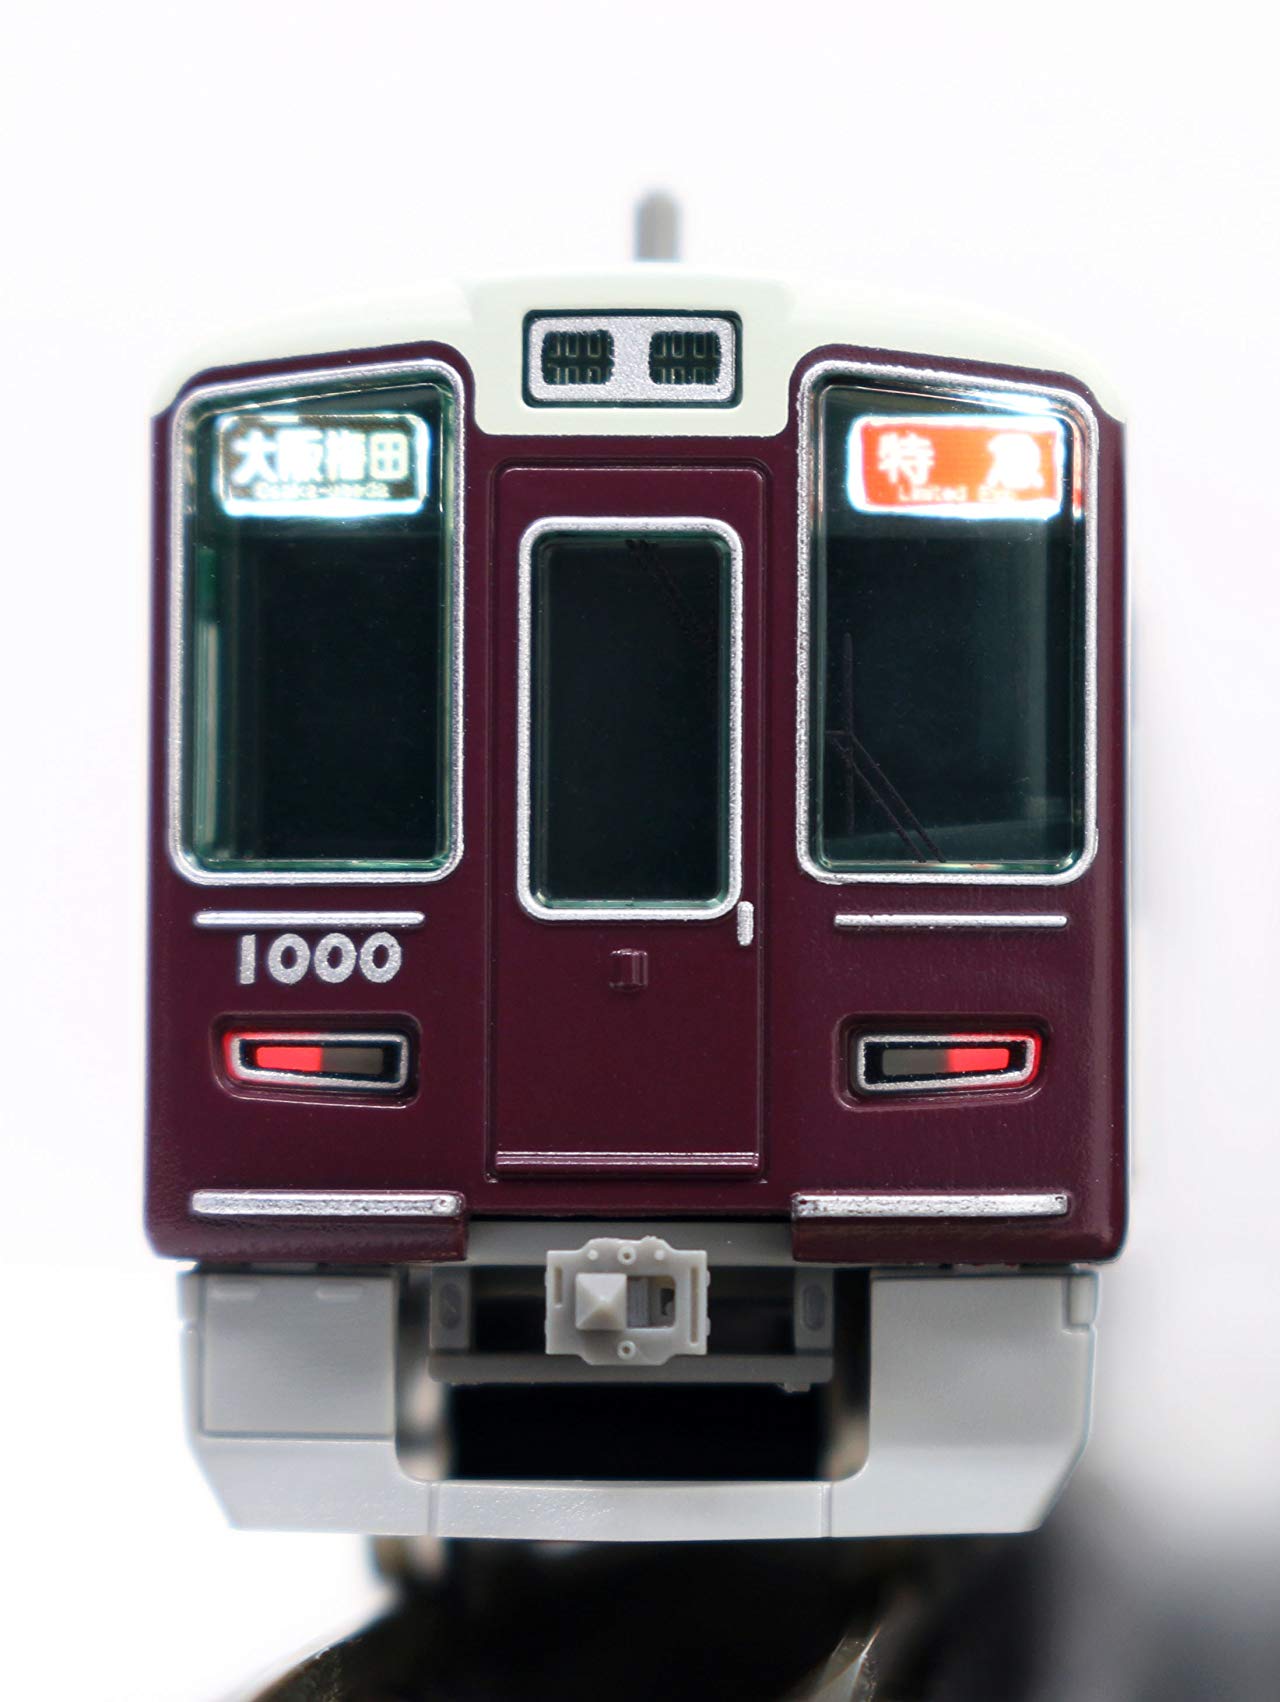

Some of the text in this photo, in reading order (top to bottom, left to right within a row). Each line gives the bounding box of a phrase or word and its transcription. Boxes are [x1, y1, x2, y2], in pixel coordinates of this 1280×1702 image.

[231, 428, 409, 484] 大阪梅田
[239, 931, 402, 985] 1000
